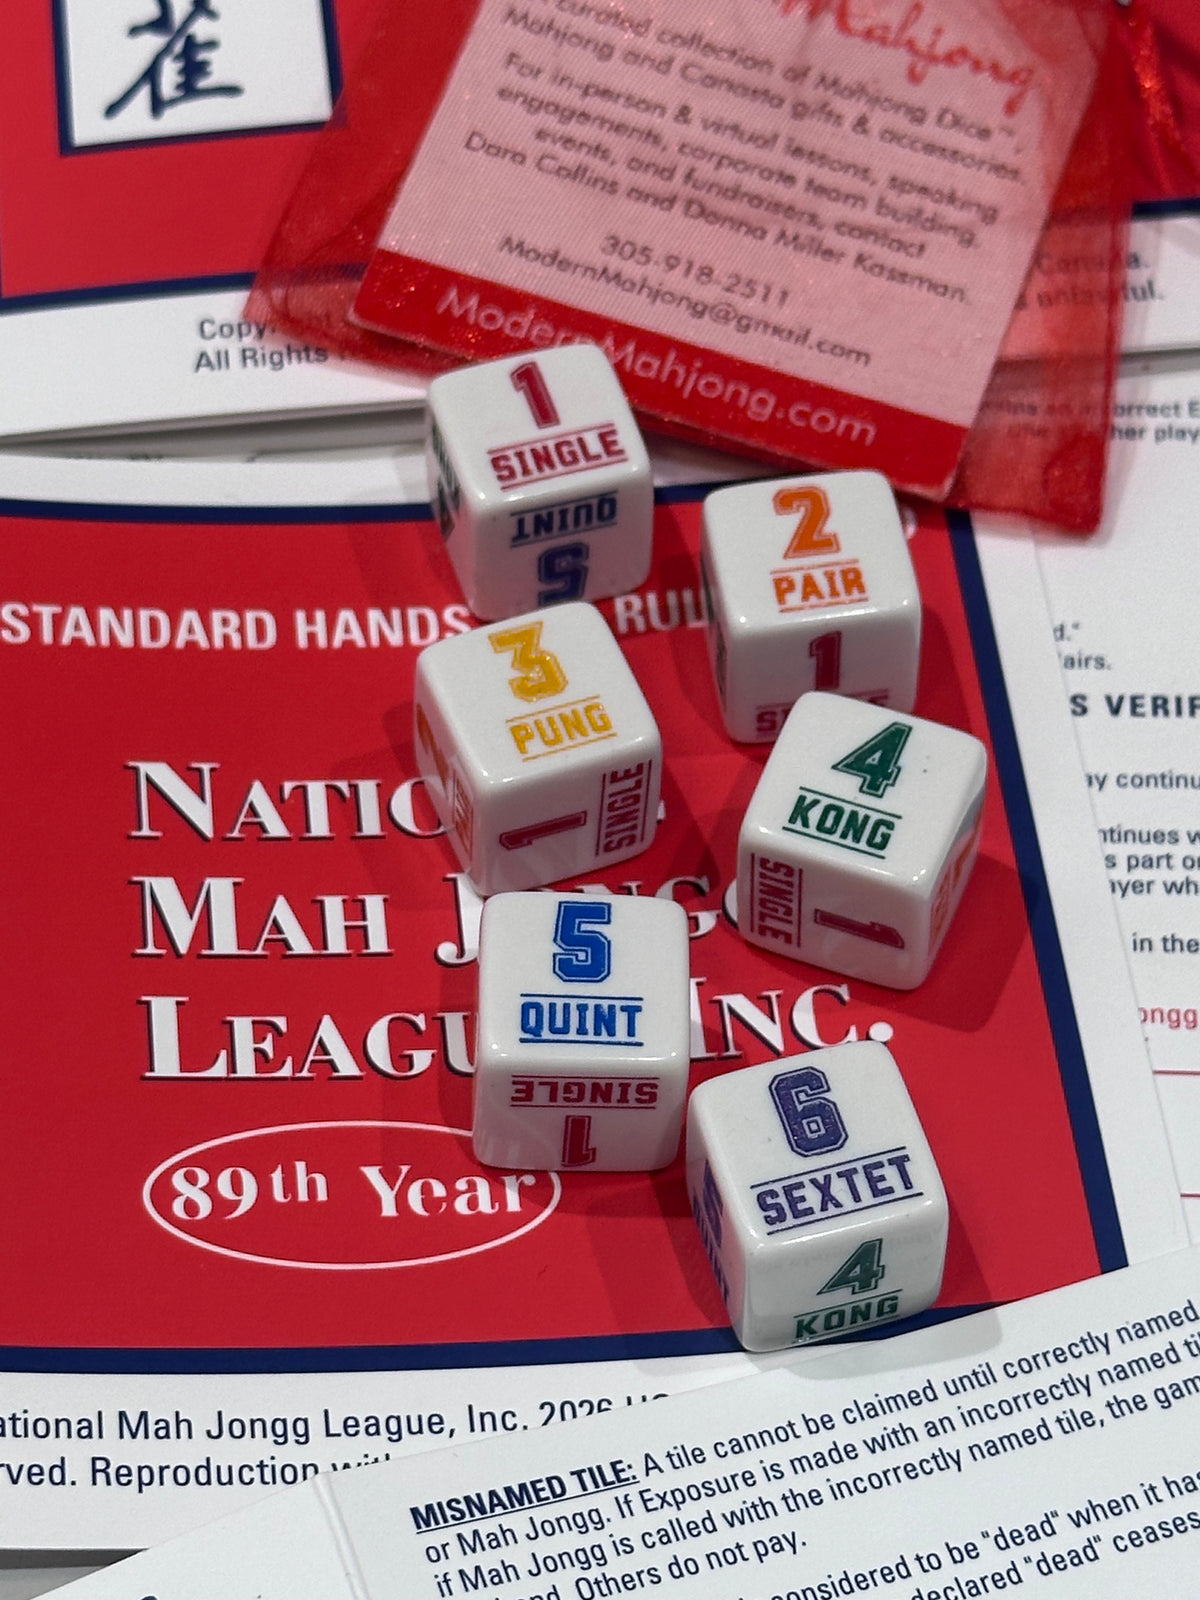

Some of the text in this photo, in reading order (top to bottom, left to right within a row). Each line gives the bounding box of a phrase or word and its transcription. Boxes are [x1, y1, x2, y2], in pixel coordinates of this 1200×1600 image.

[505, 7, 615, 63] Mahjong
[622, 50, 675, 75] and
[679, 62, 785, 110] Canasta
[790, 101, 843, 127] gifts
[852, 113, 869, 135] &
[657, 29, 774, 74] collection
[783, 65, 812, 83] of
[815, 72, 927, 126] Mahjong
[498, 88, 668, 153] engagements,
[678, 142, 797, 188] corporate
[805, 177, 868, 210] team
[505, 52, 998, 226] For in-person & virtual lessons, speaking
[464, 130, 527, 166] Dara
[536, 153, 619, 195] Collins
[627, 187, 677, 212] and
[684, 197, 768, 241] Donna
[773, 228, 846, 264] Miller
[535, 129, 926, 259] events, and fundraisers, contact
[500, 235, 872, 368] ModernMahjong@gmail.com
[195, 344, 329, 372] All Rights
[509, 361, 560, 430] 1
[490, 428, 626, 483] SINGLE
[1110, 424, 1146, 440] her
[509, 496, 618, 543] QUINT
[772, 485, 842, 560] 2
[1, 586, 708, 651] STANDARD HANDS RUL
[772, 566, 867, 606] PAIR
[488, 620, 568, 703] 3
[809, 630, 842, 690] 1
[1059, 651, 1112, 670] airs.
[510, 701, 613, 755] PUNG
[1104, 693, 1200, 718] VERIF
[831, 721, 913, 798] 4
[1116, 768, 1200, 790] continu
[125, 761, 460, 842] NATIO
[500, 810, 588, 851] 1
[604, 761, 645, 854] SINGLE
[788, 793, 896, 852] KONG
[1127, 852, 1173, 873] part
[128, 875, 395, 957] MAH
[758, 857, 795, 945] SINGLE
[814, 908, 905, 949] 1
[553, 901, 612, 983] 5
[1132, 931, 1200, 953] in the
[138, 995, 478, 1081] LEAGU
[520, 1001, 643, 1038] QUINT
[511, 1080, 659, 1105] SINGLE
[768, 1066, 849, 1158] 6
[561, 1115, 597, 1168] 1
[360, 1164, 538, 1217] Year
[756, 1154, 915, 1227] SEXTET
[816, 1238, 886, 1295] 4
[795, 1295, 900, 1340] KONG
[118, 1410, 193, 1440] Mah
[206, 1409, 310, 1446] Jongg
[323, 1408, 456, 1443] League,
[468, 1404, 529, 1433] Inc.
[410, 1299, 1200, 1530] MISNAMED TILE: A tile cannot be claimed until correctly named
[91, 1456, 319, 1494] Reproduction
[425, 1541, 450, 1564] or
[457, 1523, 518, 1556] Mah
[526, 1505, 612, 1543] Jongg.
[615, 1493, 635, 1520] If
[642, 1470, 757, 1512] Exposure
[759, 1459, 785, 1483] is
[789, 1441, 859, 1475] made
[862, 1422, 919, 1455] with
[923, 1415, 956, 1439] an
[956, 1373, 1092, 1428] incorrectly
[1097, 1341, 1182, 1386] named
[434, 1571, 453, 1598] if
[458, 1559, 520, 1592] Mah
[527, 1548, 608, 1577] Jongg
[611, 1533, 635, 1557] is
[641, 1509, 717, 1550] called
[722, 1499, 779, 1530] with
[781, 1487, 824, 1513] the
[826, 1447, 963, 1502] incorrectly
[968, 1417, 1053, 1463] named
[1055, 1407, 1105, 1436] tile,
[1105, 1394, 1148, 1420] the
[914, 1551, 943, 1574] to
[944, 1541, 981, 1565] be
[981, 1509, 1060, 1552] "dead"
[1067, 1493, 1140, 1530] when
[1139, 1482, 1164, 1505] it
[575, 1566, 662, 1600] Others
[667, 1554, 701, 1580] do
[705, 1542, 750, 1571] not
[752, 1531, 807, 1563] pay.
[1023, 1533, 1102, 1578] "dead"
[1112, 1511, 1200, 1553] ceases
